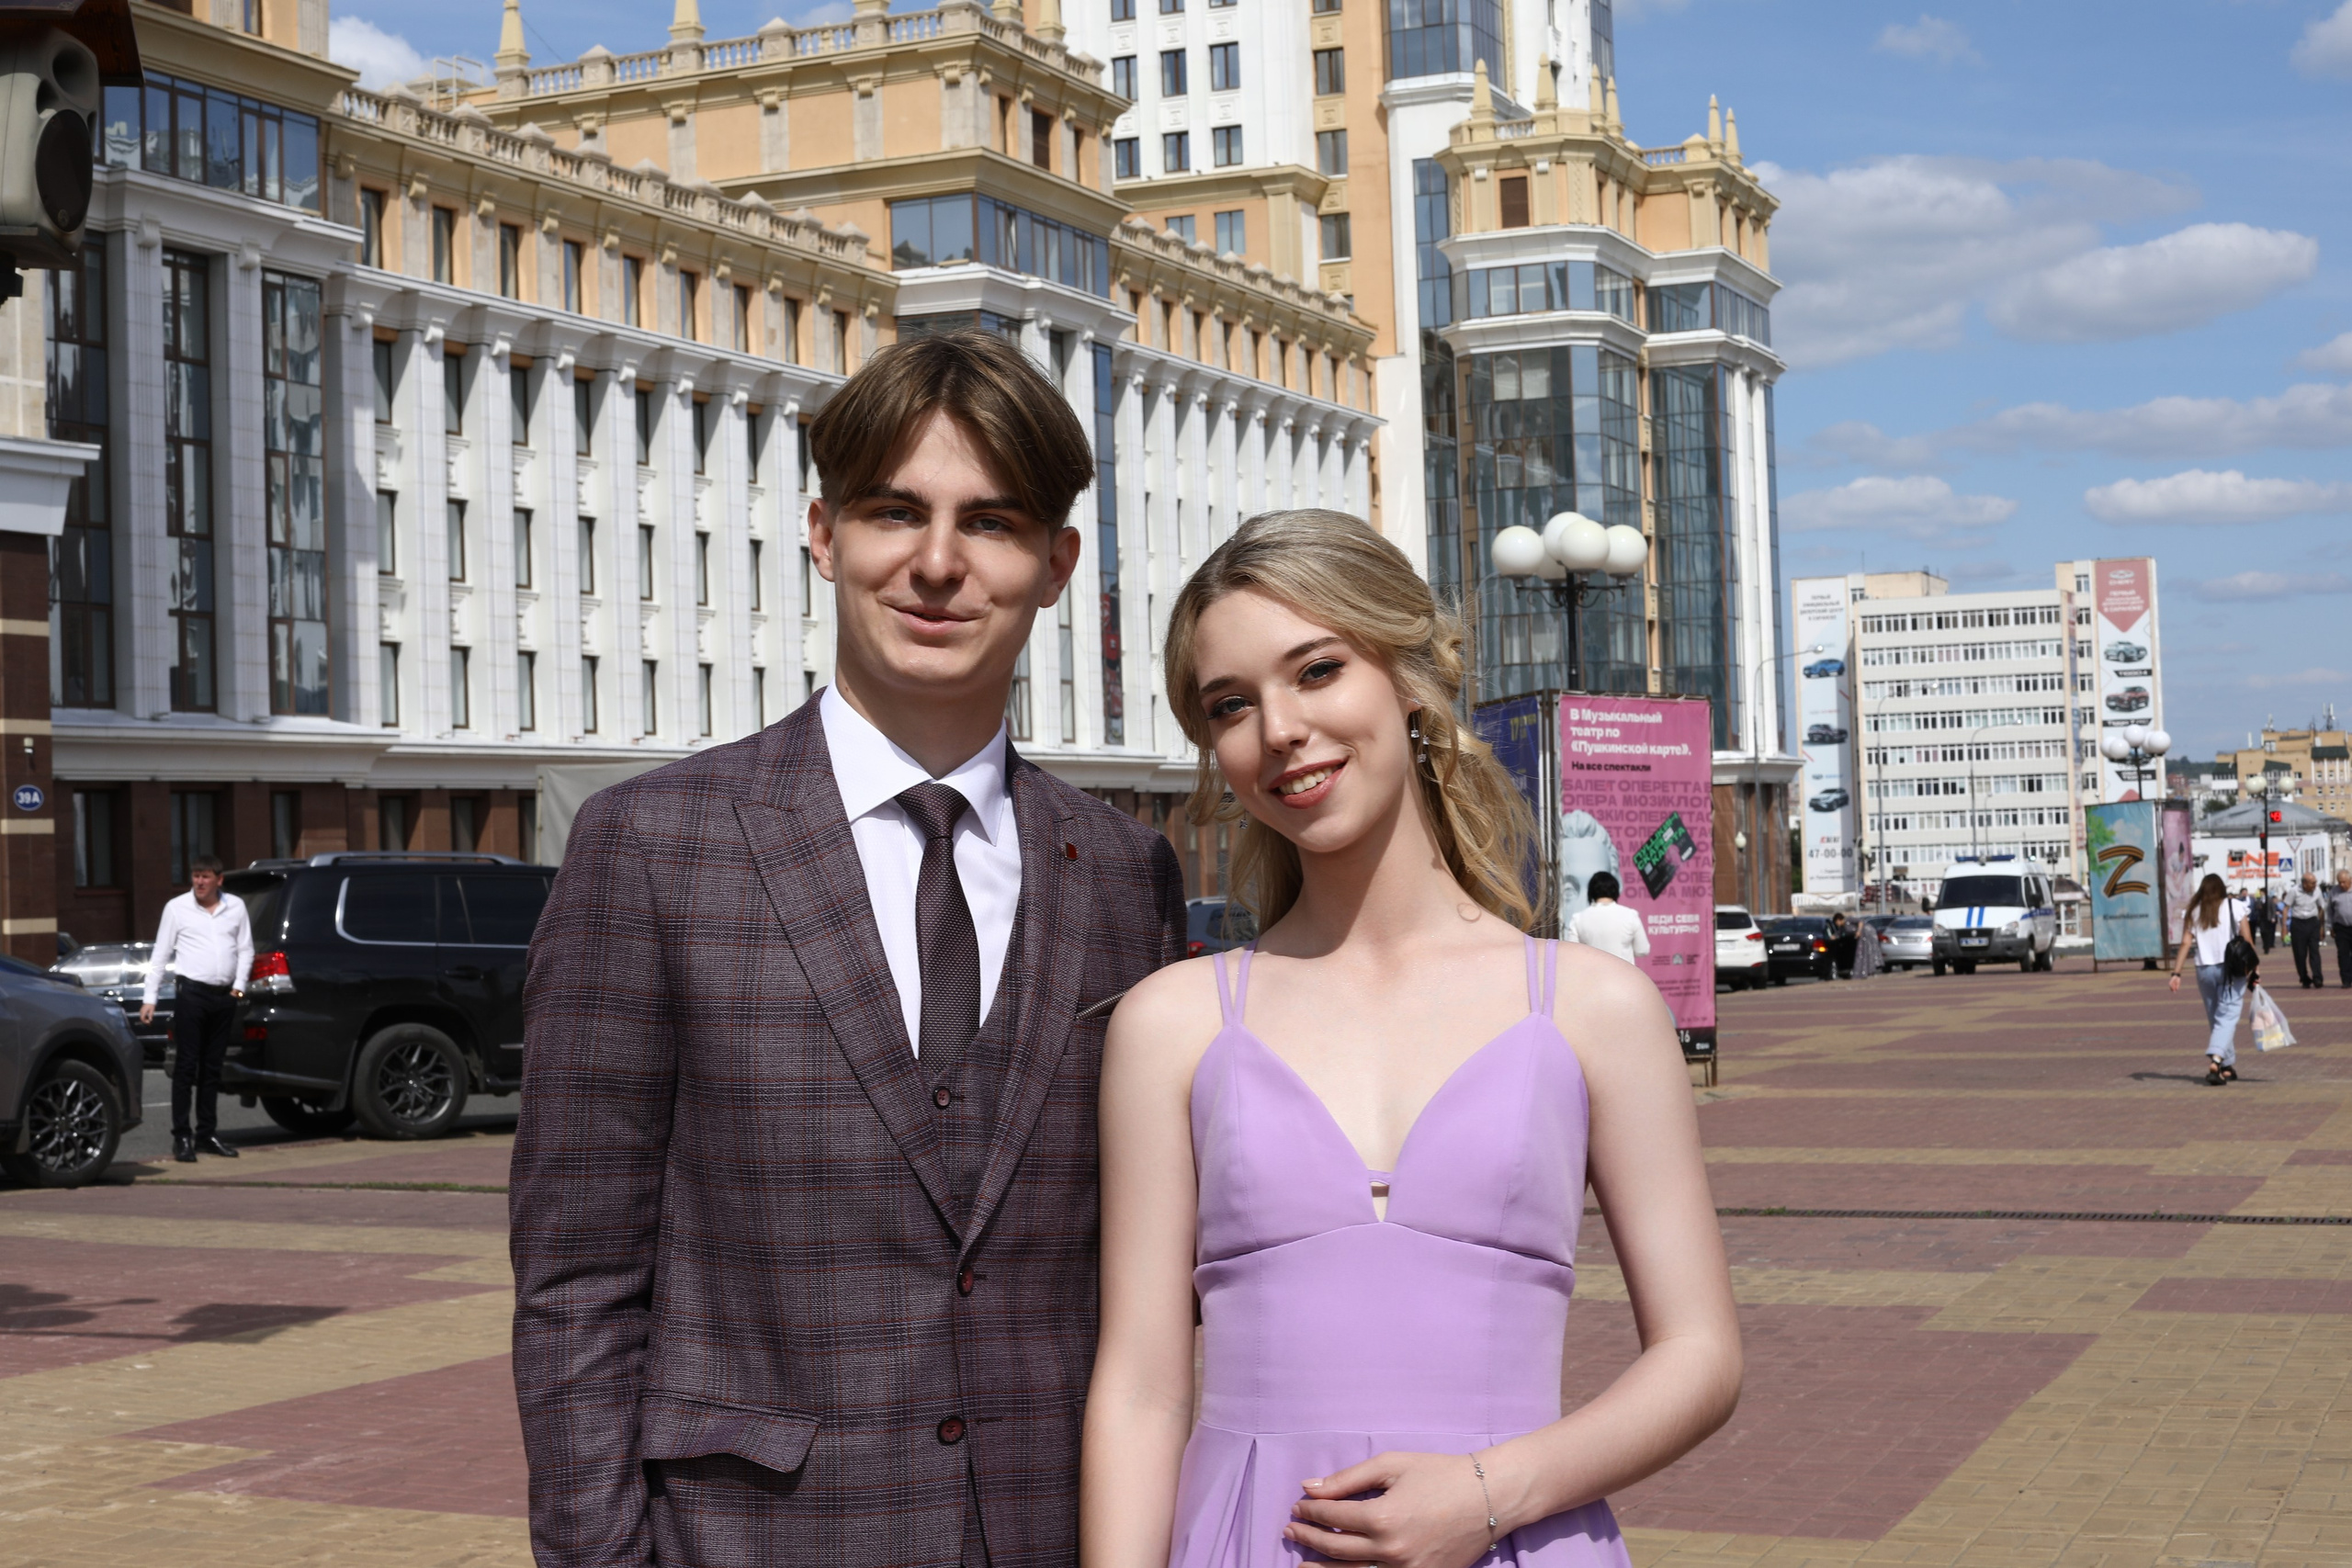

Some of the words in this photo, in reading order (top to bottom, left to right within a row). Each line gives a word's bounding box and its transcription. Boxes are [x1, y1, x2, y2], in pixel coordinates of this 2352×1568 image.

[1570, 708, 1579, 720] В
[1581, 708, 1662, 724] Музыкальный
[1570, 726, 1603, 740] театр
[1606, 728, 1621, 738] по
[1571, 740, 1648, 756] «Пушкинской
[1572, 761, 1584, 770] На
[1586, 762, 1602, 771] все
[1604, 763, 1651, 772] спектакли
[1563, 779, 1614, 792] БАЛЕТ
[1618, 781, 1702, 794] ОПЕРЕТТА
[1563, 794, 1617, 807] ОПЕРА
[1648, 924, 1700, 935] КУЛЬТУРНО
